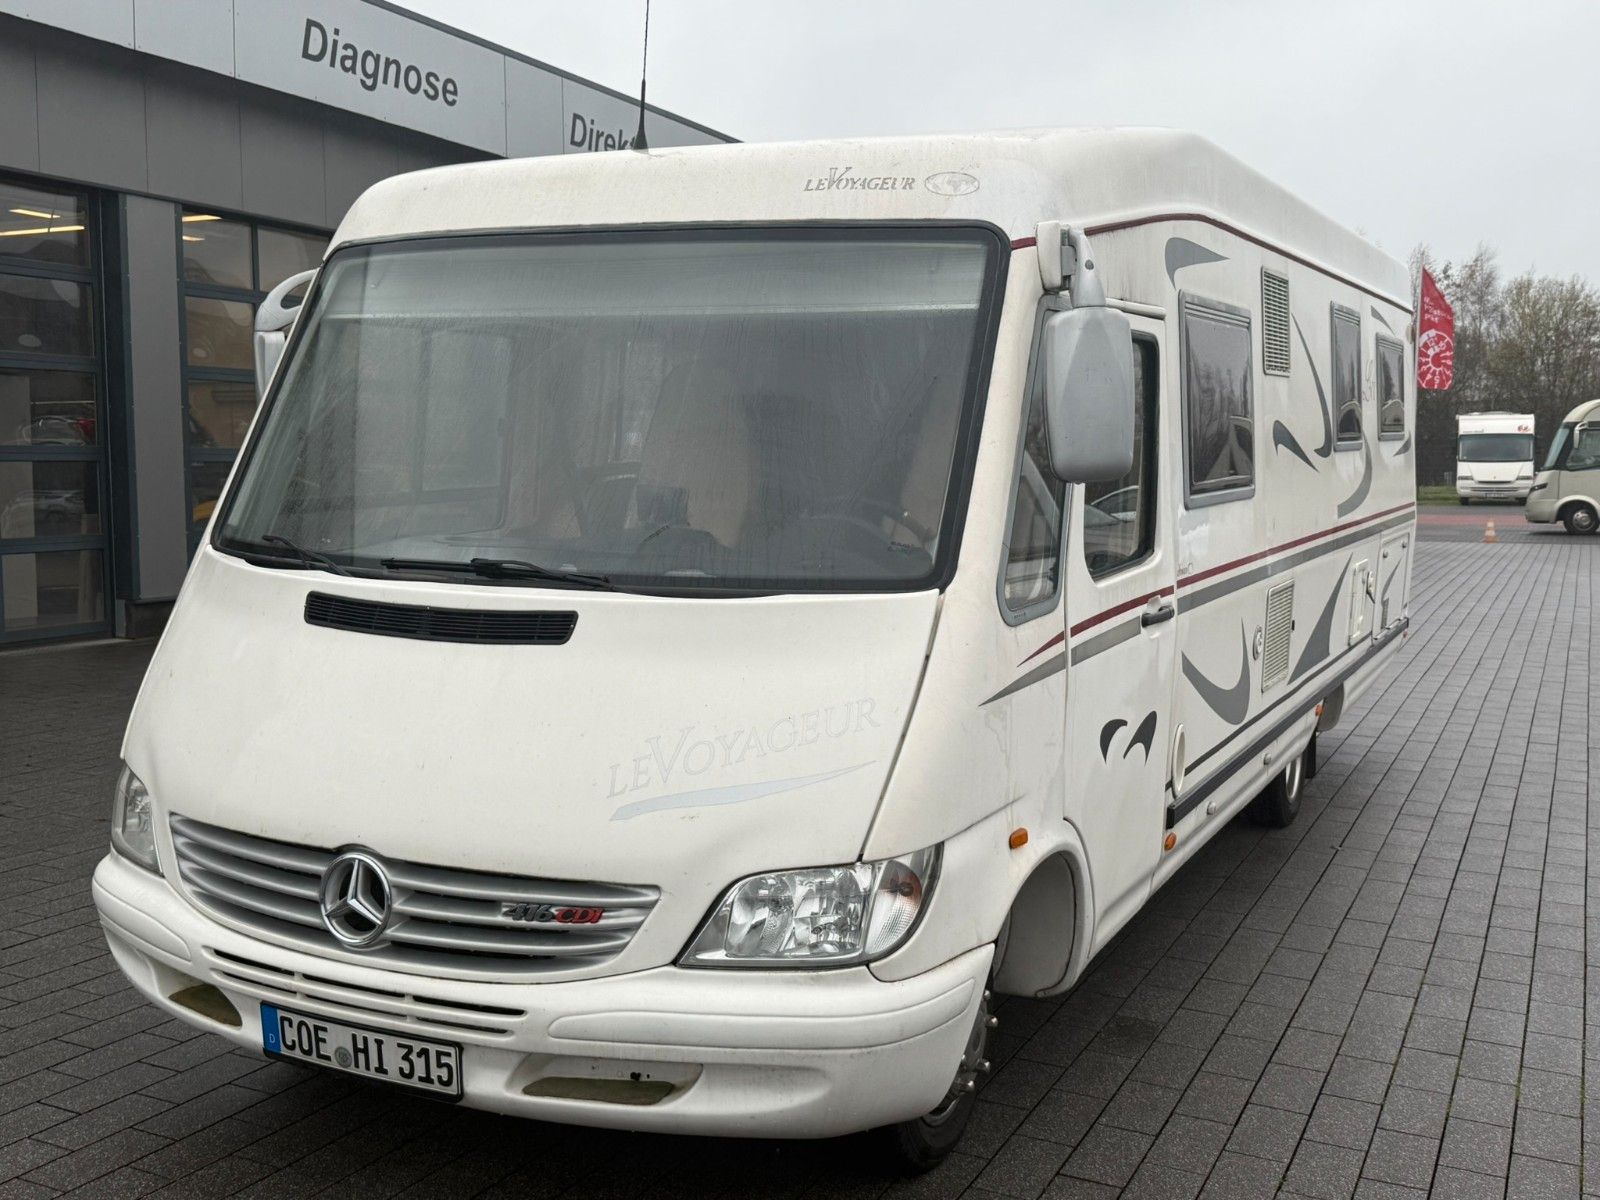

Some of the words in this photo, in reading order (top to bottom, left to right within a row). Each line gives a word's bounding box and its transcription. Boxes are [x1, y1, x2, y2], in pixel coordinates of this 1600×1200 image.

[302, 18, 458, 107] Diagnose
[268, 1033, 276, 1044] D
[279, 1015, 332, 1062] COE
[351, 1032, 389, 1076] HI
[396, 1042, 454, 1088] 315
